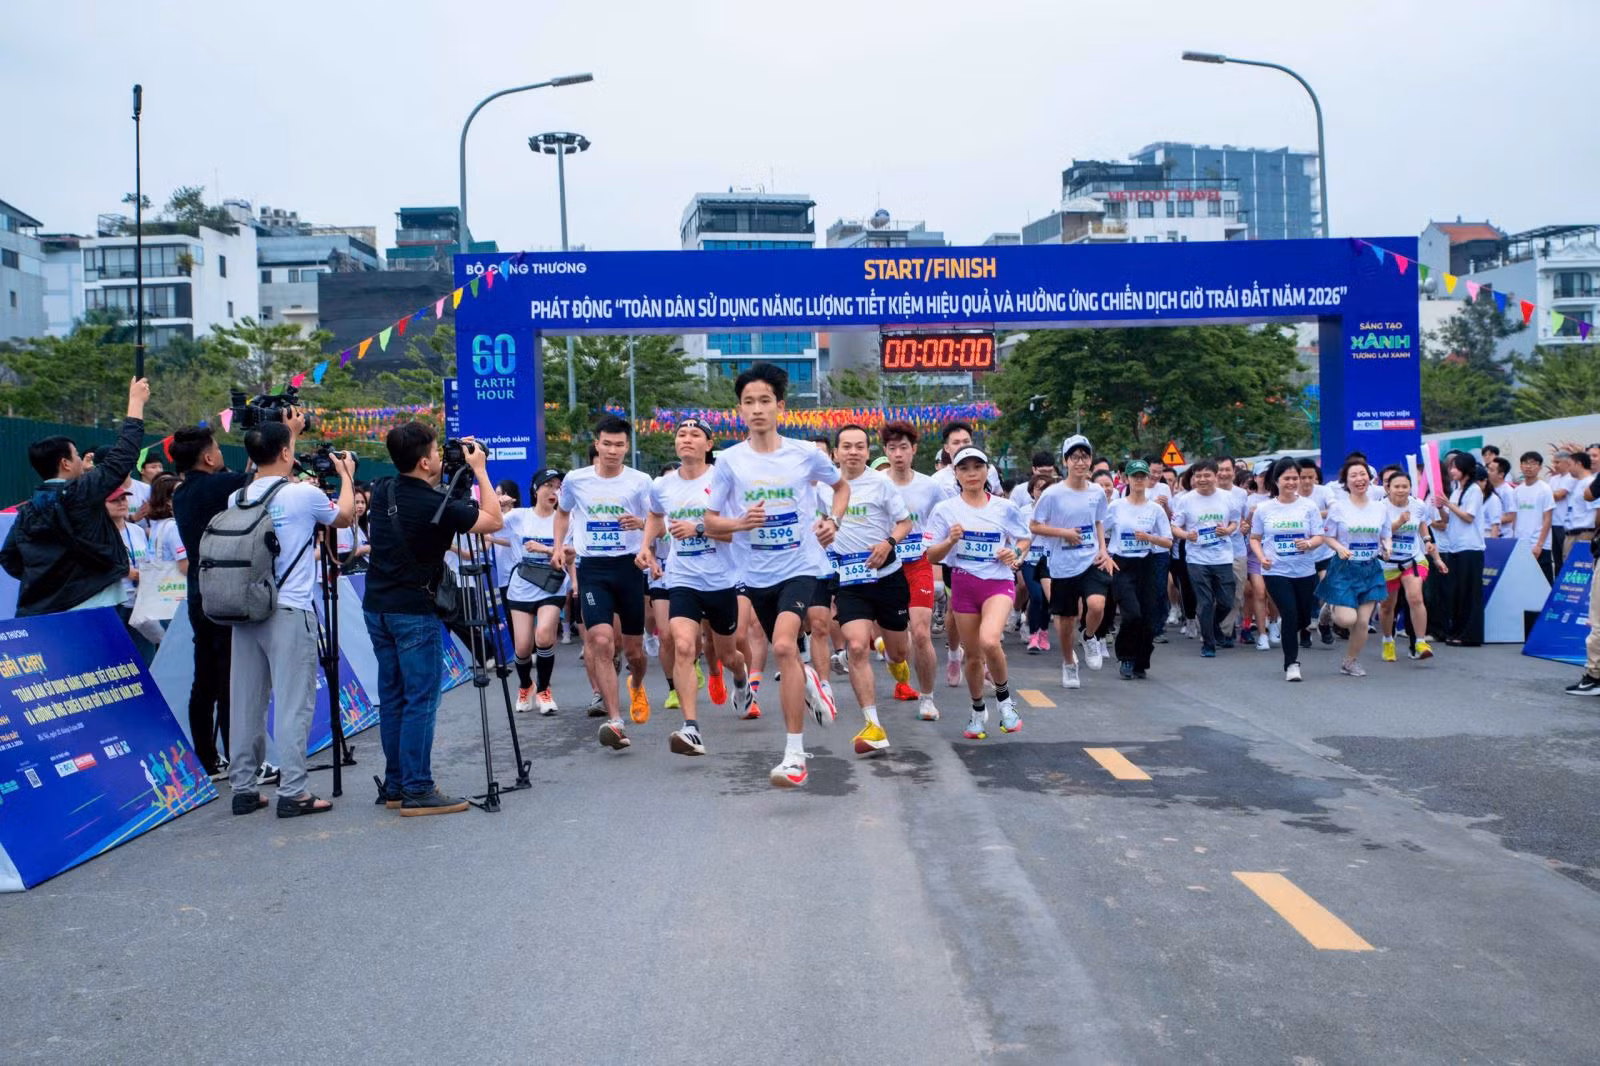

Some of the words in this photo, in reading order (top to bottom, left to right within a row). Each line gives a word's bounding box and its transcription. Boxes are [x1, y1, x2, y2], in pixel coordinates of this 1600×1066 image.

[1177, 190, 1222, 200] TRAVEL
[532, 262, 587, 274] THƯƠNG
[864, 257, 997, 282] START/FINISH
[531, 296, 570, 319] PHÁT
[572, 296, 612, 323] ĐỘNG
[665, 295, 695, 318] DÂN
[698, 292, 717, 317] SỬ
[720, 298, 759, 322] DỤNG
[762, 294, 803, 316] NĂNG
[806, 294, 853, 320] LƯỢNG
[856, 288, 886, 315] TIẾT
[889, 292, 924, 319] KIỆM
[926, 291, 959, 318] HIỆU
[962, 288, 992, 317] QUẢ
[994, 290, 1014, 312] VÀ
[1016, 287, 1066, 312] HƯỞNG
[1068, 288, 1098, 312] ỨNG
[1101, 284, 1143, 310] CHIẾN
[1146, 291, 1178, 314] DỊCH
[1180, 286, 1204, 309] GIỜ
[1206, 285, 1239, 308] TRÁI
[1241, 282, 1270, 307] ĐẤT
[1272, 284, 1306, 306] NĂM
[1360, 322, 1384, 330] SÁNG
[1385, 322, 1403, 331] TẠO
[1350, 332, 1410, 350] XANH
[472, 333, 516, 376] 60
[884, 338, 992, 368] 00:00:00
[474, 378, 516, 388] EARTH
[477, 390, 515, 400] HOUR
[492, 435, 511, 443] ĐỒNG
[592, 532, 619, 541] 3.443
[758, 527, 793, 539] 3.596
[965, 542, 993, 552] 3.301
